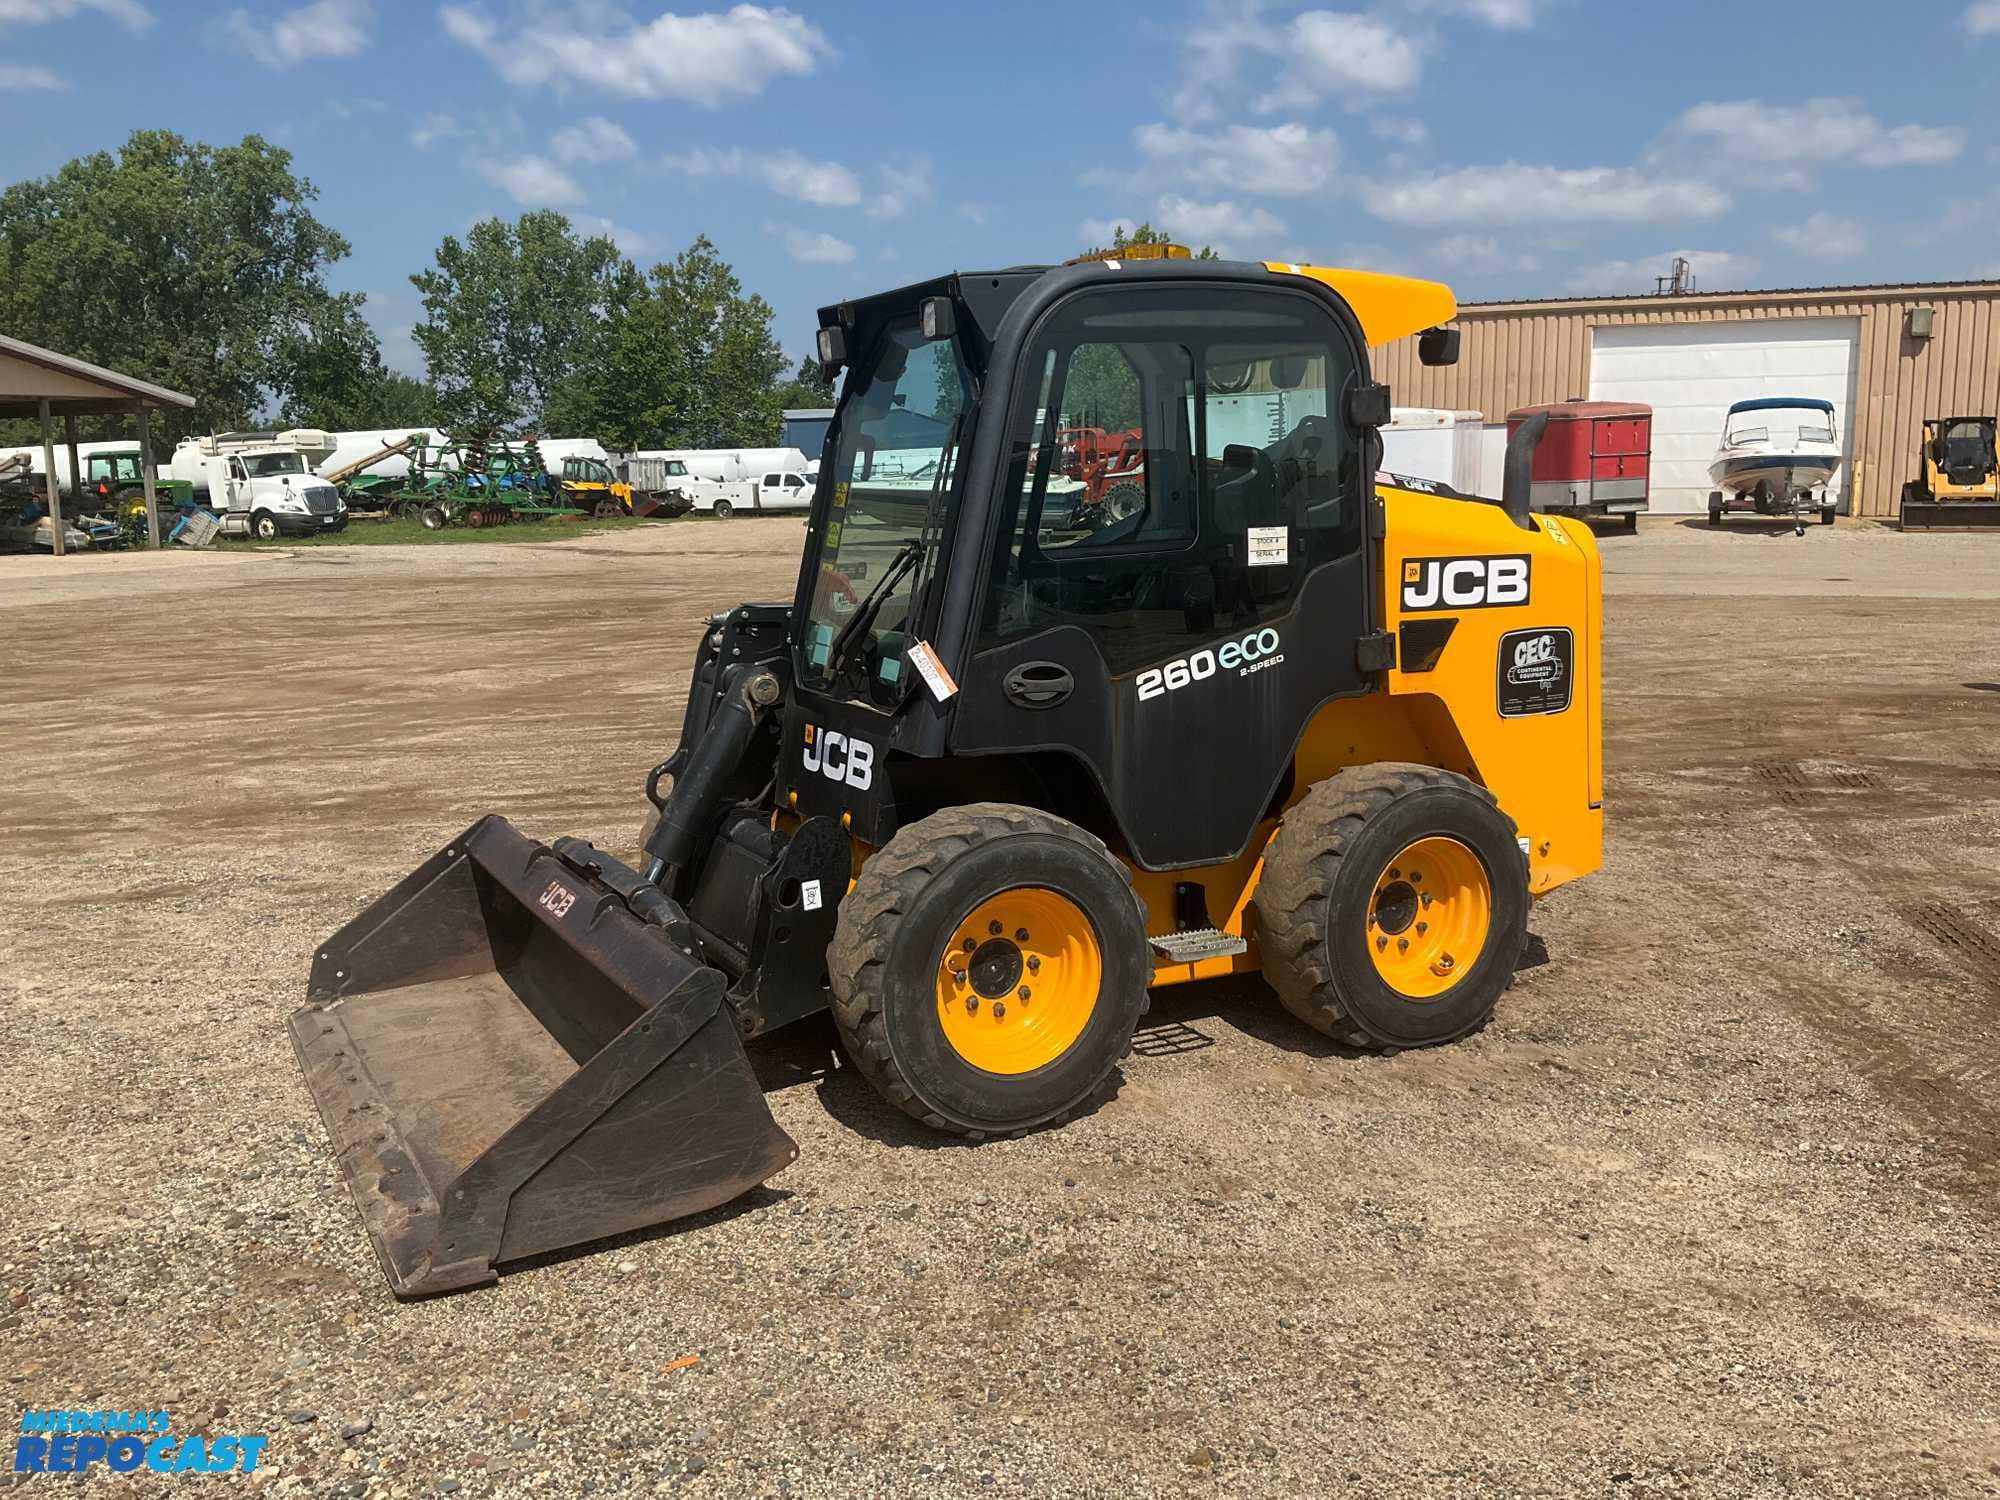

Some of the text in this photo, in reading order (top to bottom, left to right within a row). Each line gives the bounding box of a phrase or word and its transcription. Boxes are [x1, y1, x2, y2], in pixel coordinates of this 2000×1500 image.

[1404, 559, 1528, 607] JCB
[1136, 628, 1280, 701] 260 eco
[1240, 655, 1285, 677] 2-SPEED
[1514, 635, 1555, 667] CEC
[1517, 666, 1552, 674] CONTINENTAL
[1519, 671, 1549, 679] EQUIPMENT
[802, 727, 875, 791] JCB
[539, 882, 576, 918] JCB
